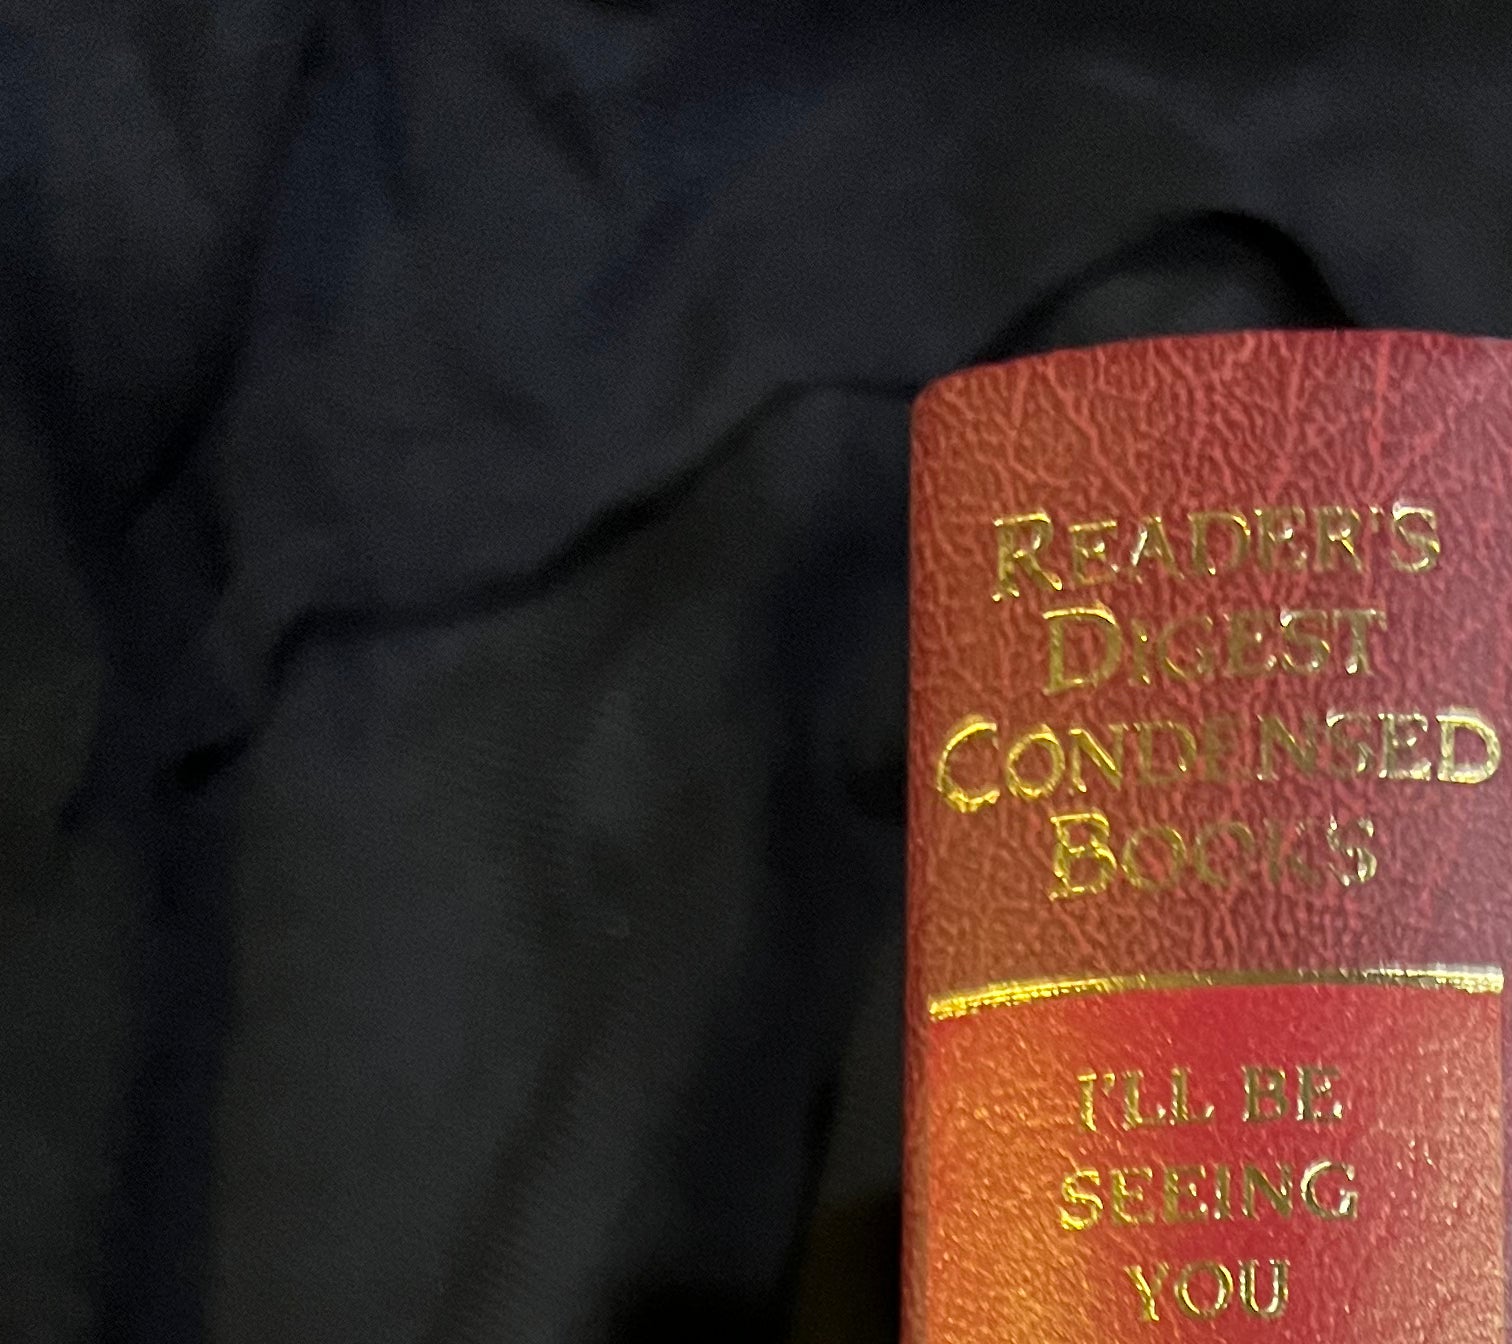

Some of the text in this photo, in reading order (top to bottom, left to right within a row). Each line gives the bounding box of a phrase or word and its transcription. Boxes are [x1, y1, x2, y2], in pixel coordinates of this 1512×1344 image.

[992, 505, 1441, 602] READER'S
[1042, 603, 1388, 697] DIGEST
[936, 703, 1501, 814] CONDENSED
[1048, 810, 1379, 901] BOOKS
[1077, 1064, 1343, 1132] I'LL BE
[1057, 1160, 1359, 1231] SEEING
[1123, 1258, 1290, 1321] YOU
